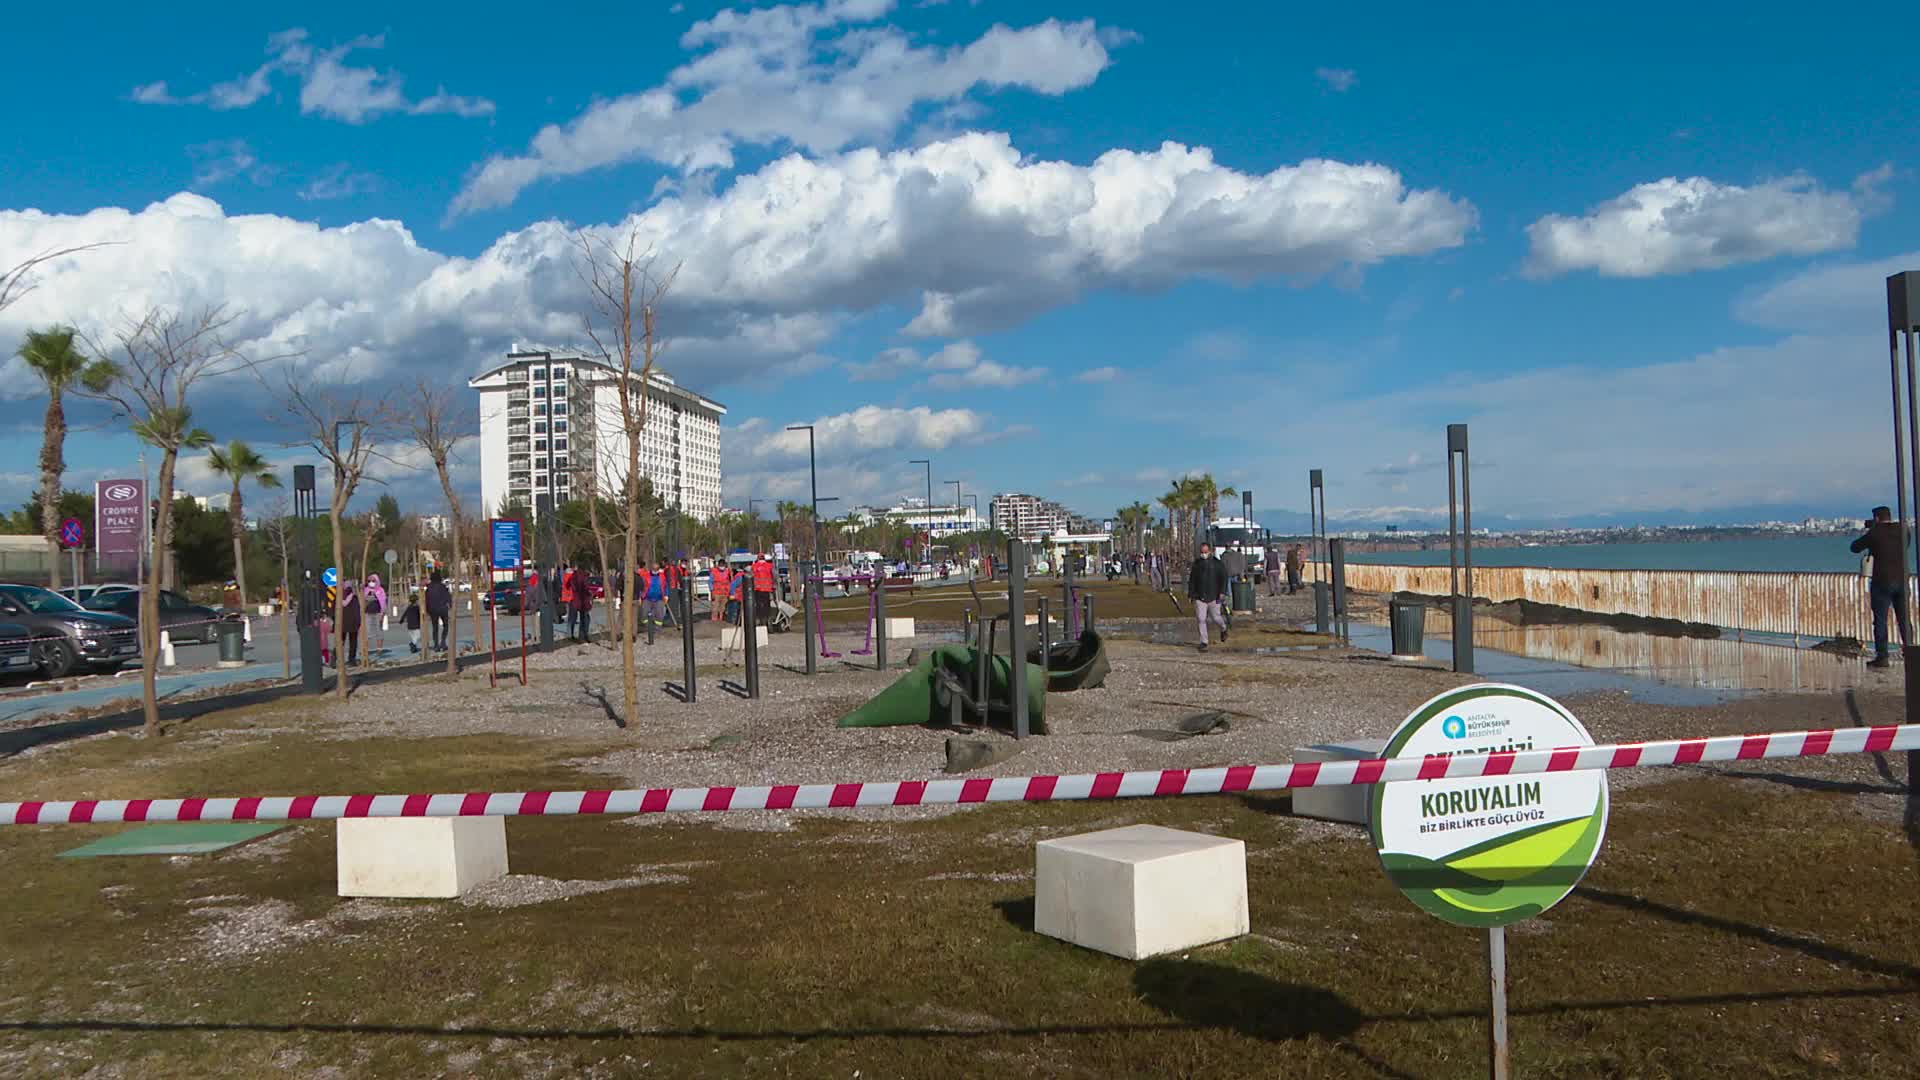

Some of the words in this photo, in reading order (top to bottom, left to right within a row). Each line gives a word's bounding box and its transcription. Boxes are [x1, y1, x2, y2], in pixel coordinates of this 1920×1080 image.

[103, 506, 140, 516] CROWNE
[107, 517, 135, 526] PLAZA
[1468, 713, 1496, 721] ANTALYA
[1421, 781, 1541, 818] KORUYALIM
[1420, 822, 1437, 833] BİZ
[1439, 817, 1486, 832] BİRLİKTE
[1488, 810, 1545, 826] GÜÇLÜYÜZ
